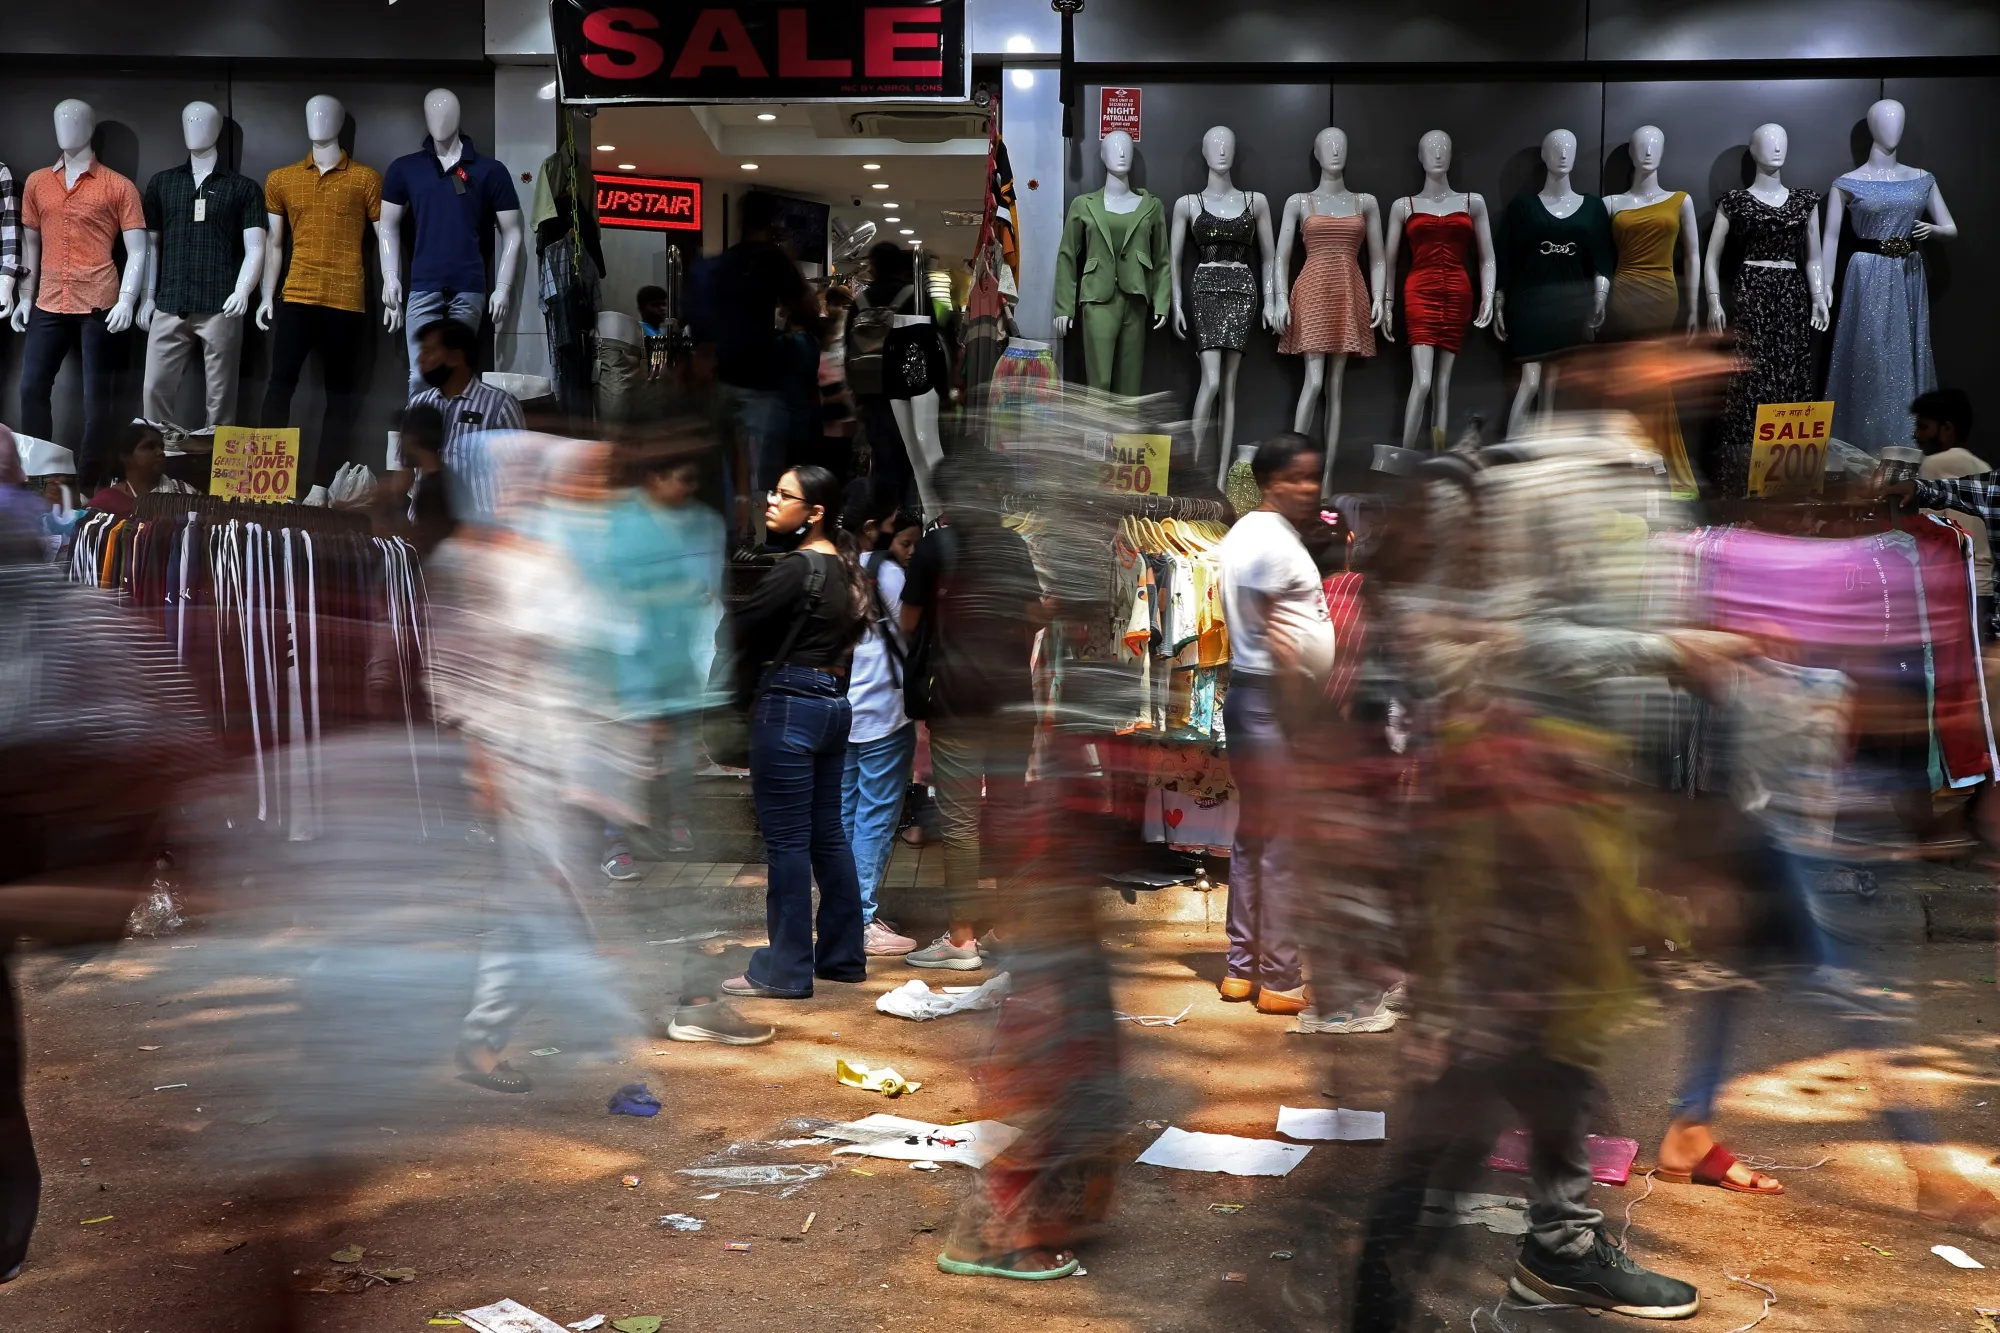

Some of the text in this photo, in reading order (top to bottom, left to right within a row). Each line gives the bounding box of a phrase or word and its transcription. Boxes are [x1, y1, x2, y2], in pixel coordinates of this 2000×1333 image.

[579, 7, 942, 79] SALE
[861, 84, 875, 92] BY
[877, 84, 912, 92] ABROL
[914, 84, 943, 92] SONS
[1107, 107, 1136, 115] NIGHT
[597, 190, 692, 215] UPSTAIR
[1759, 421, 1825, 441] SALE
[225, 440, 287, 455] SALE
[246, 455, 295, 469] LOWER
[237, 469, 290, 494] 200
[1099, 464, 1152, 493] 250
[1873, 557, 1887, 584] ONE-STAR
